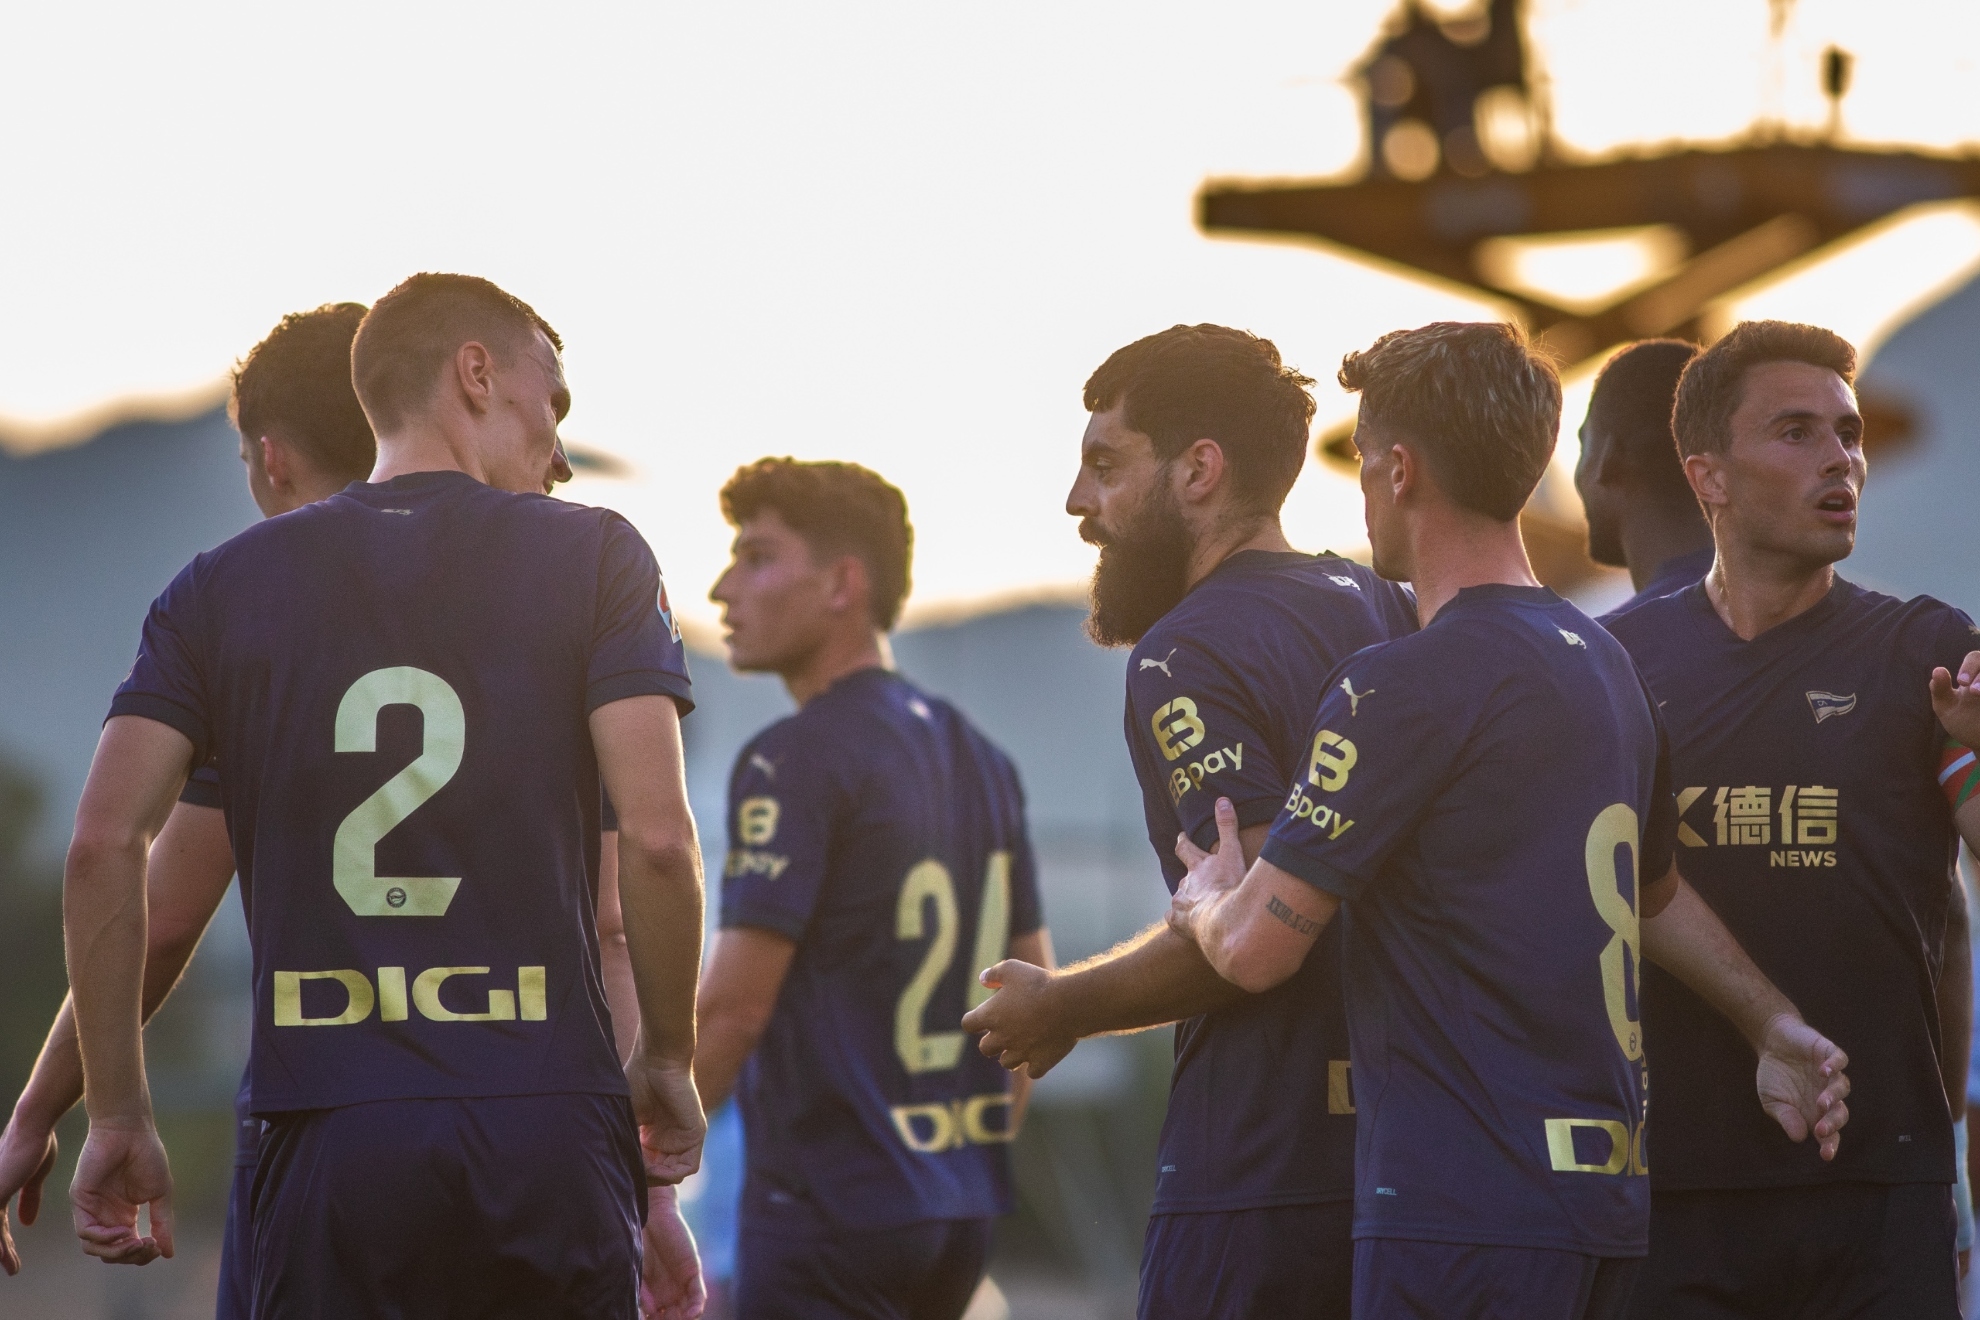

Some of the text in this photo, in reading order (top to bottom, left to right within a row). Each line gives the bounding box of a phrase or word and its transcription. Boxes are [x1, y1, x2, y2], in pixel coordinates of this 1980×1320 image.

[333, 666, 465, 917] 2
[1770, 850, 1837, 868] NEWS
[274, 966, 547, 1027] DIGI
